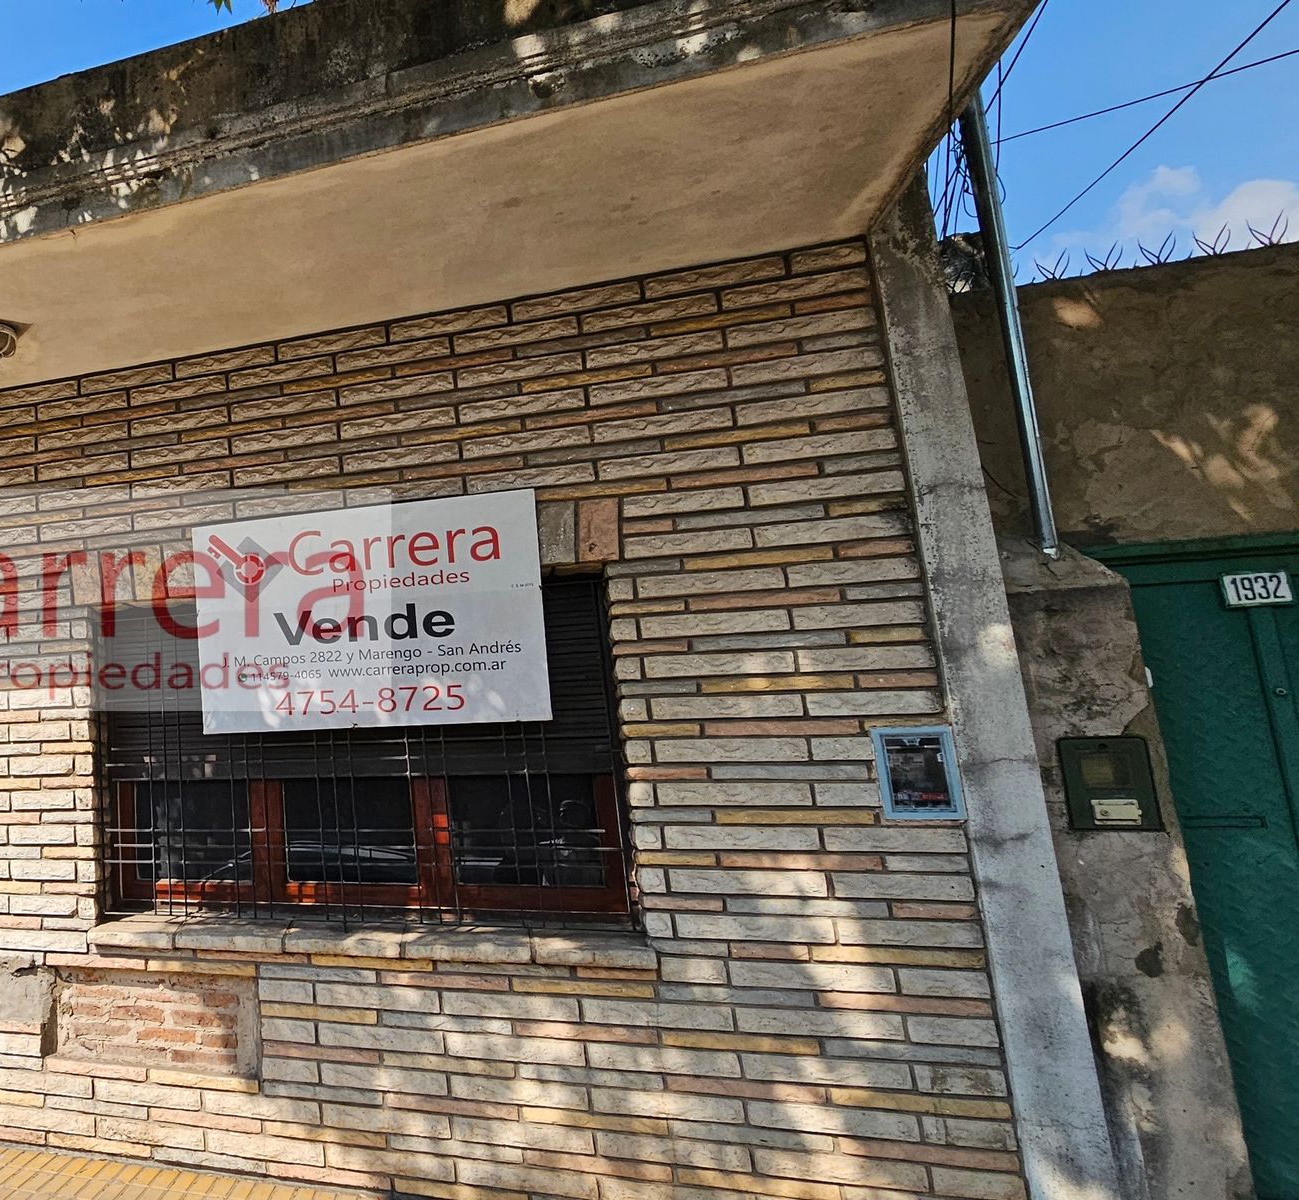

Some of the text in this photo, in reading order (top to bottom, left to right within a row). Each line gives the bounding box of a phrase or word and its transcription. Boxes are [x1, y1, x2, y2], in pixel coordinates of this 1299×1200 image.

[288, 524, 501, 576] Carrera
[333, 570, 470, 594] Propiedades
[1230, 574, 1286, 602] 1932
[273, 603, 456, 646] Vende
[234, 656, 250, 667] M.
[254, 654, 306, 669] Campos
[310, 651, 342, 663] 2822
[346, 652, 354, 664] y
[358, 648, 422, 662] Marengo
[437, 644, 464, 657] San
[469, 640, 522, 655] Andrés
[328, 660, 507, 678] www.carreraprop.com.ar
[275, 684, 466, 716] 4754-8725
